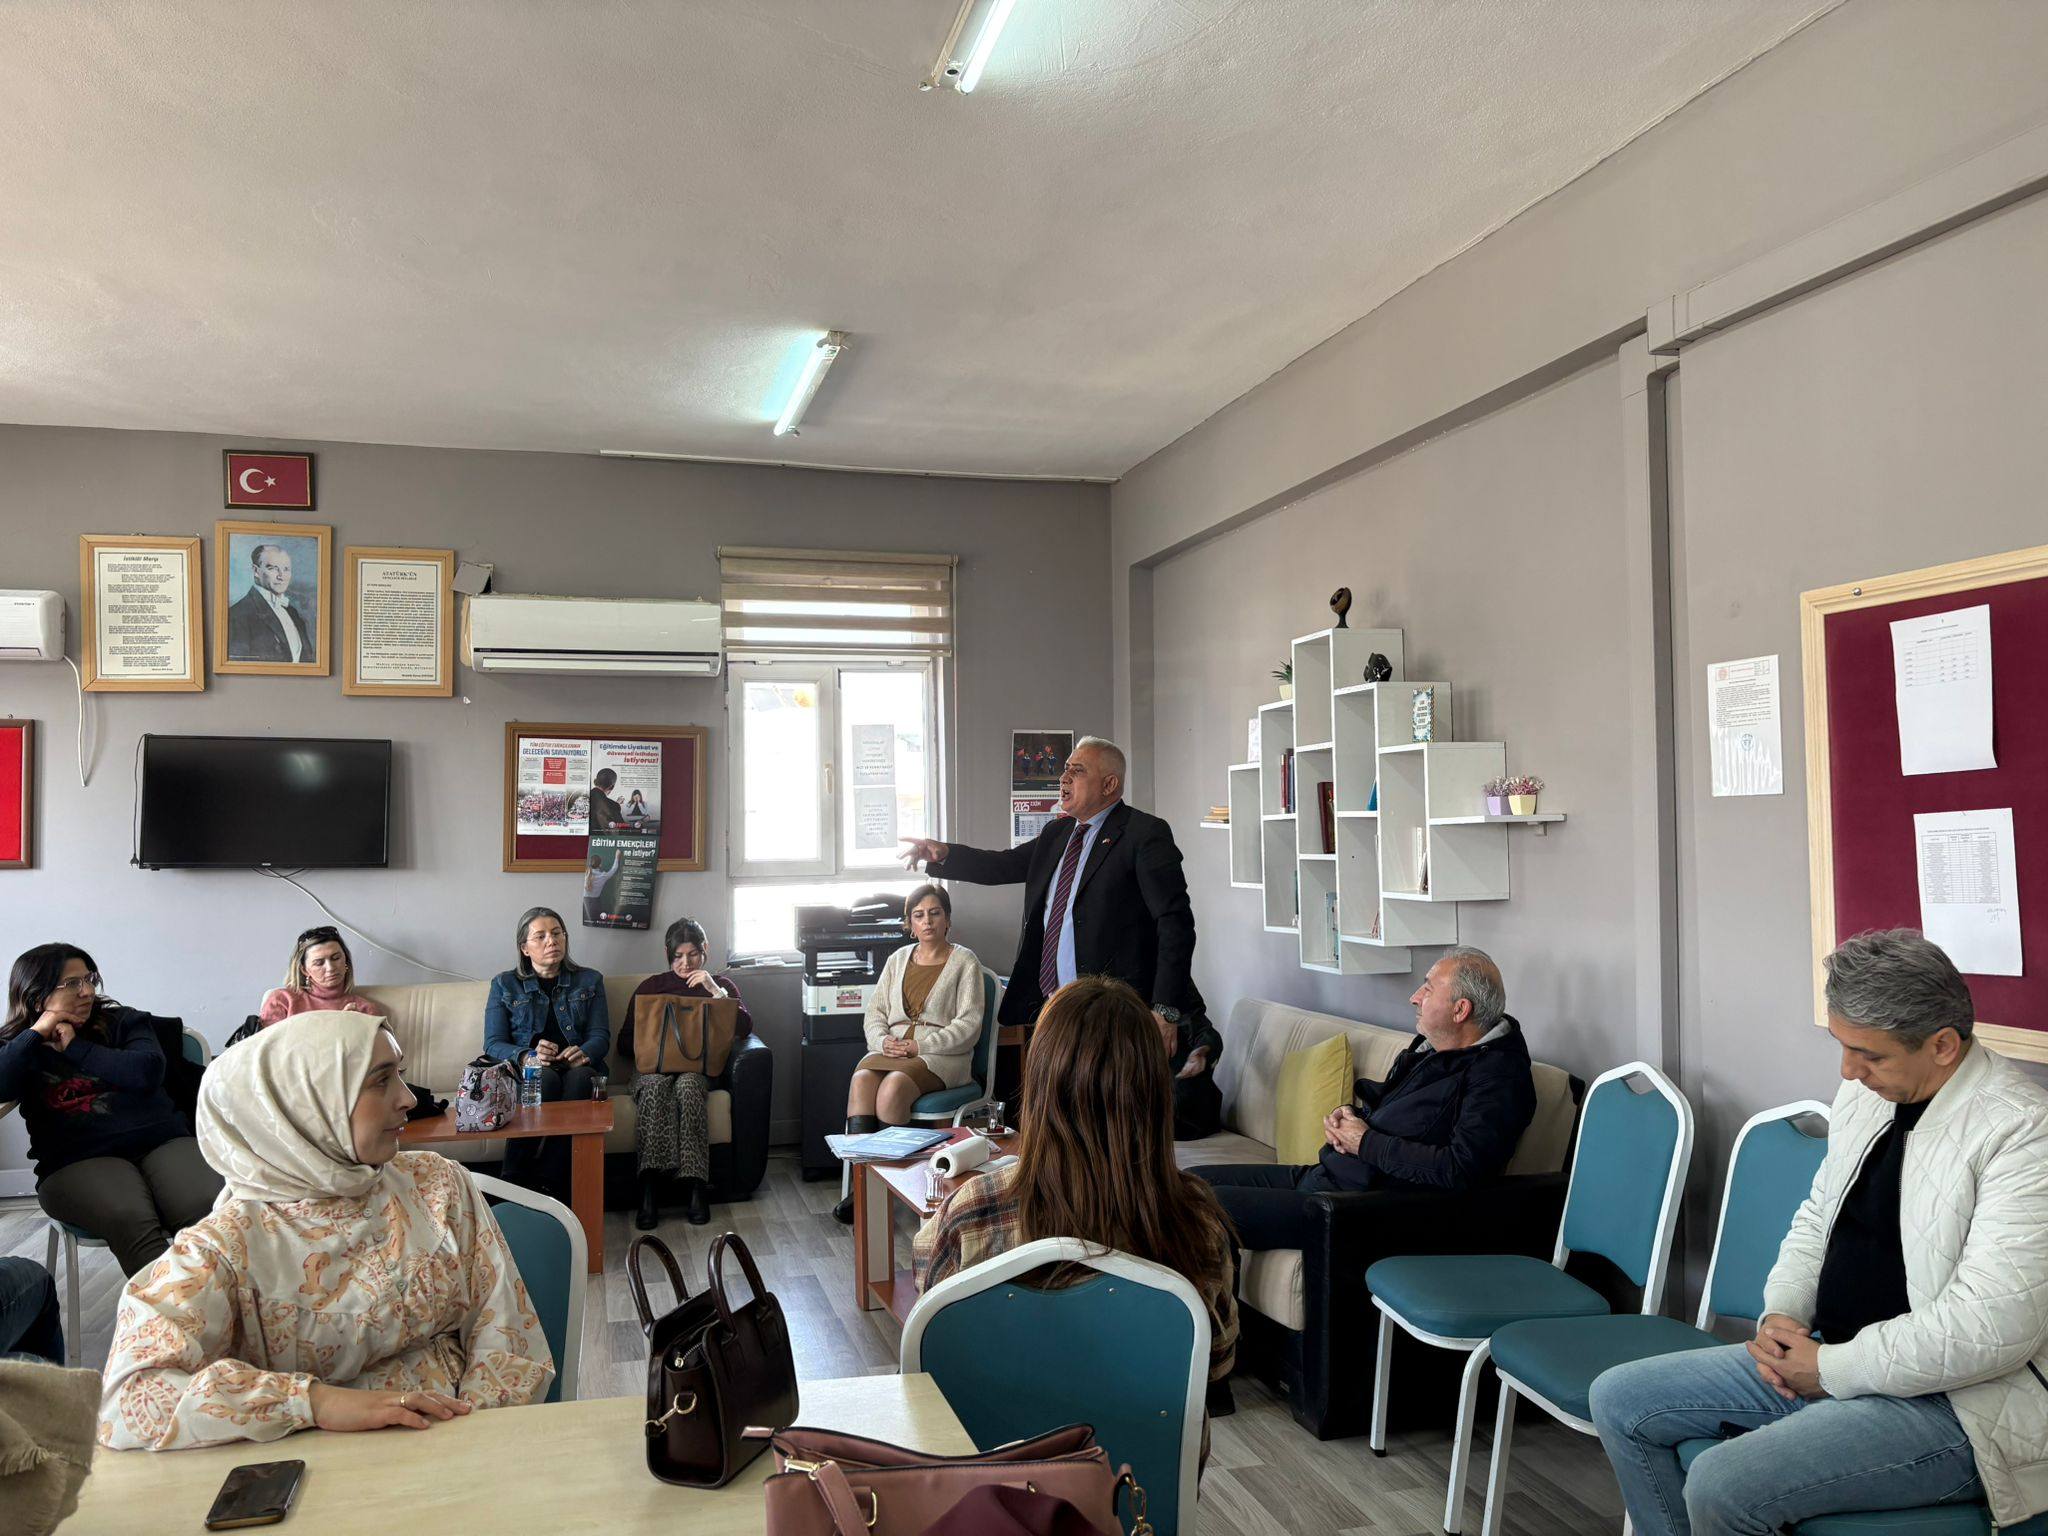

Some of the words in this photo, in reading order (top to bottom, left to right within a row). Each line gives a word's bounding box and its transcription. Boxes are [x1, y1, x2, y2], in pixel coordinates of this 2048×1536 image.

[1014, 801, 1030, 812] 2025
[591, 838, 615, 847] EĞİTİM
[616, 839, 657, 849] EMEKÇİLERİ
